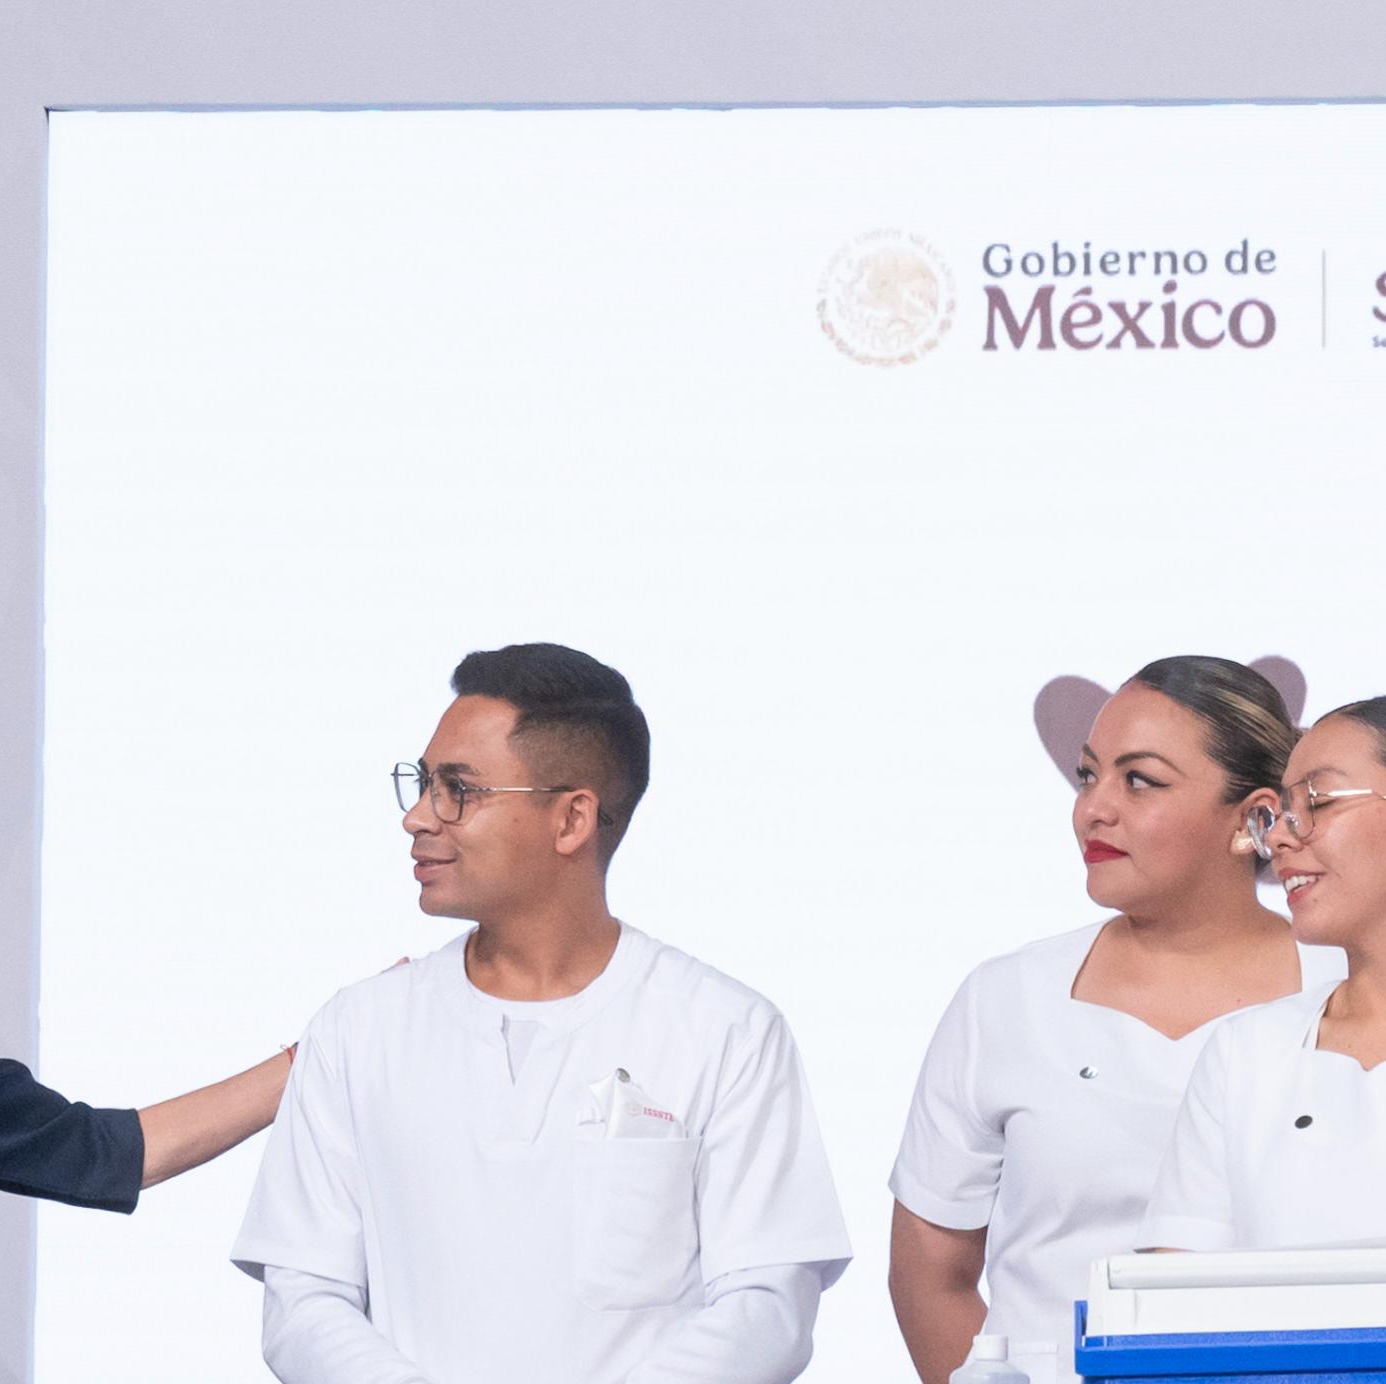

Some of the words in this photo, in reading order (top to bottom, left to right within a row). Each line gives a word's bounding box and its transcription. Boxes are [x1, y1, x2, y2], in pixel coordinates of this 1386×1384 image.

[982, 241, 1207, 277] Gobierno
[1225, 238, 1277, 275] de
[982, 280, 1277, 350] México
